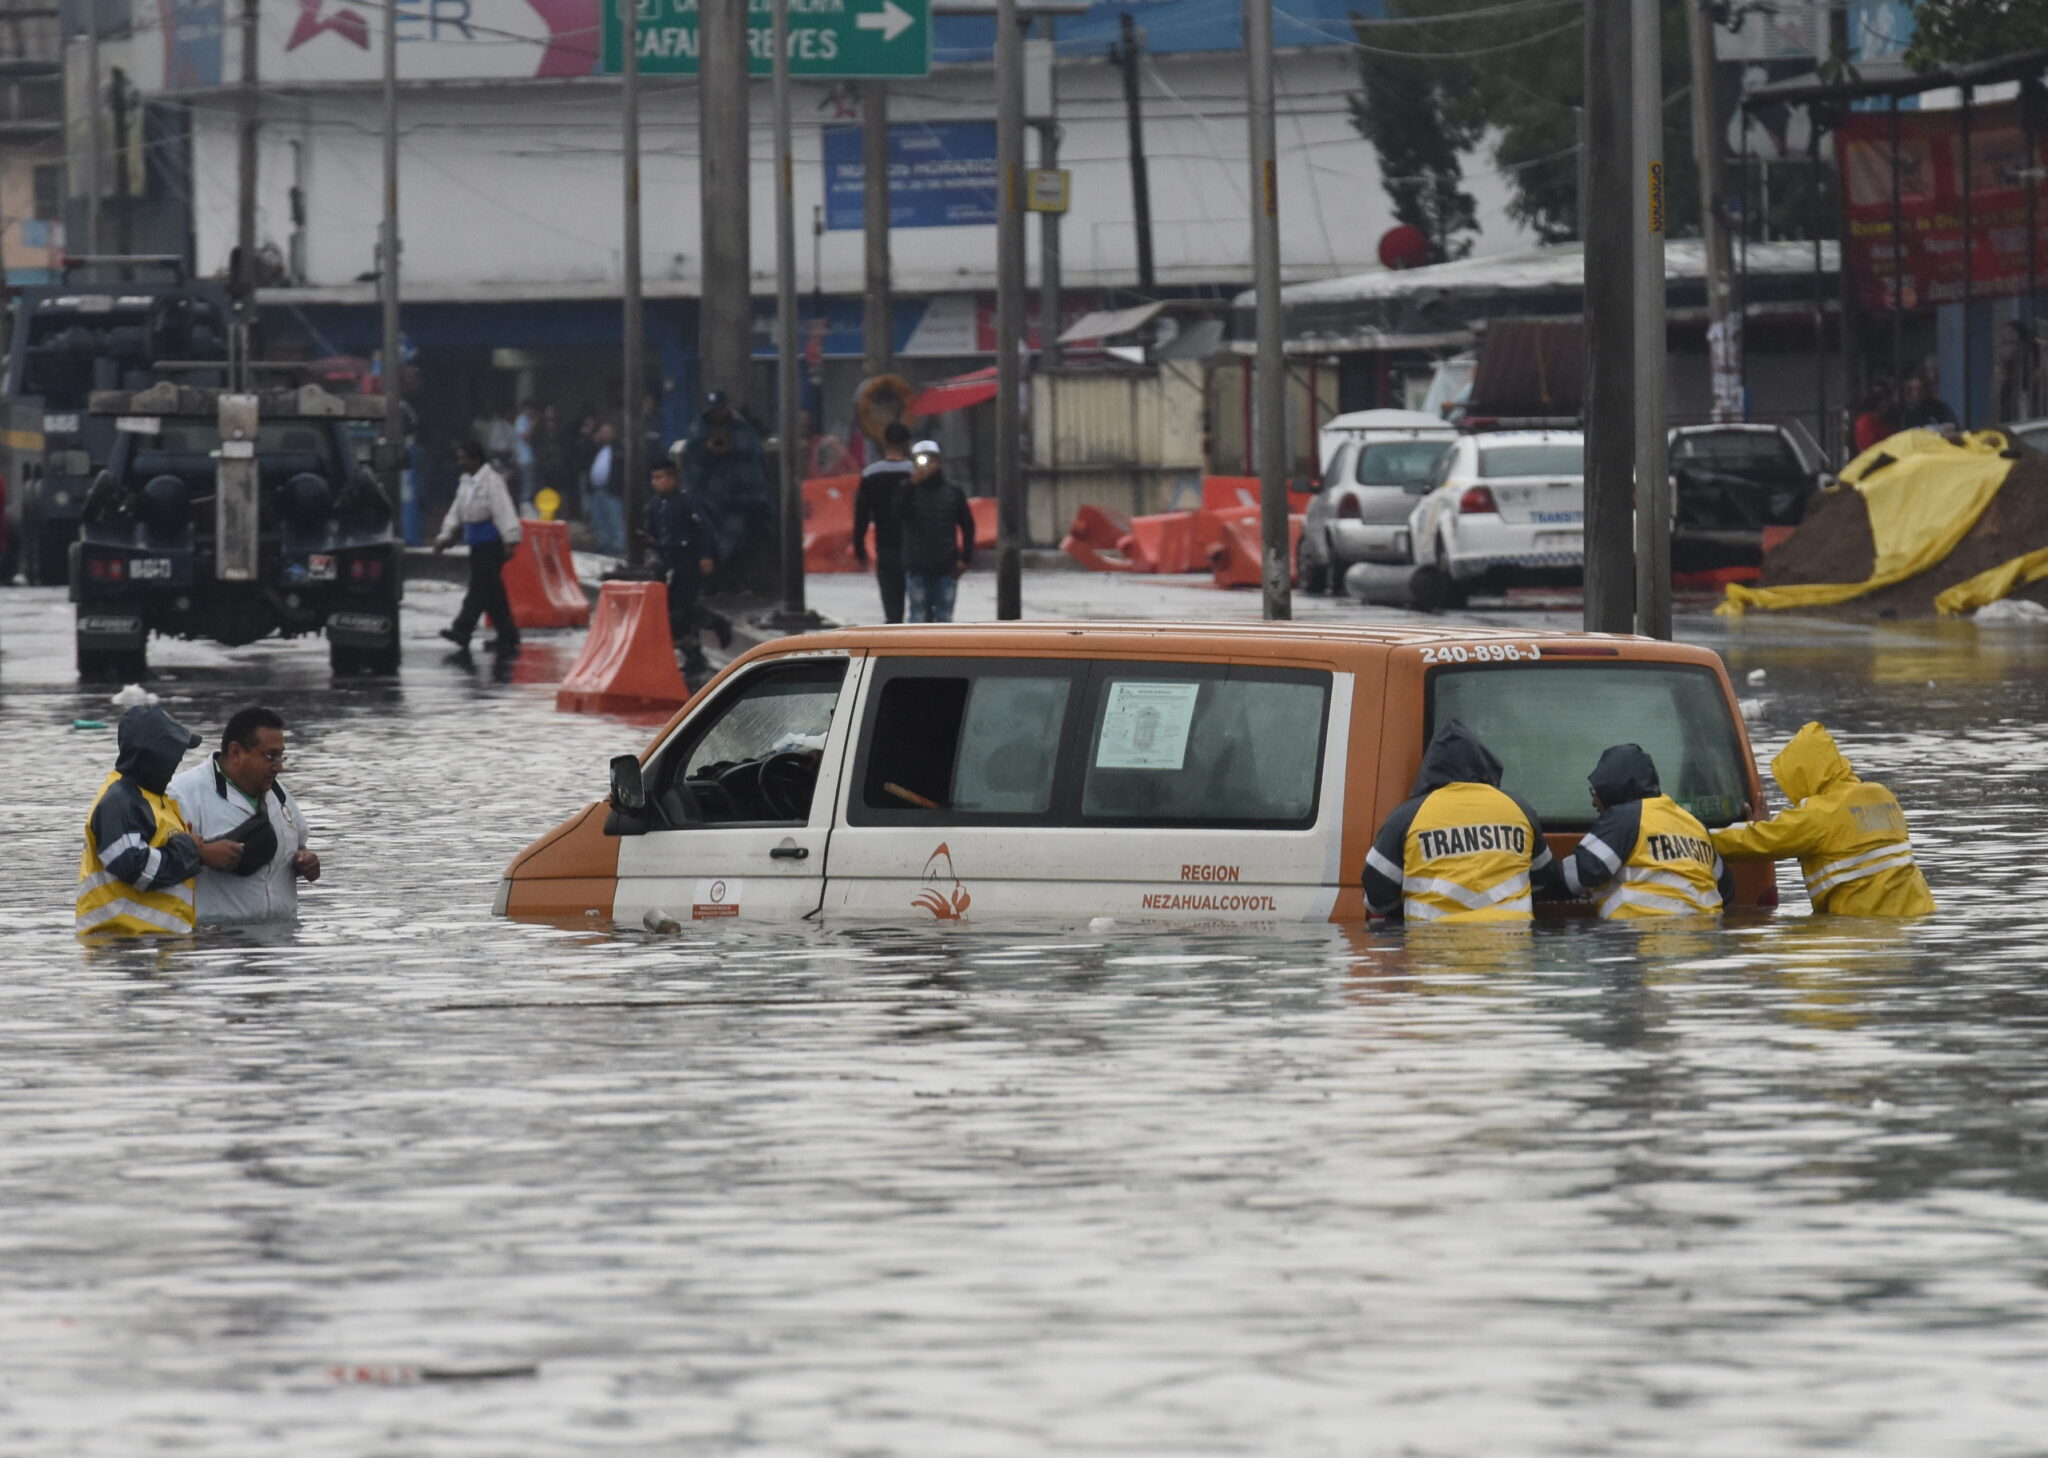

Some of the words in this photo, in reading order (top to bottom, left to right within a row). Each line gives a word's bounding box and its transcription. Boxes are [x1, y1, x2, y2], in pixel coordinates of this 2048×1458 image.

[634, 27, 698, 57] AFA
[1530, 511, 1584, 523] TRANSIT
[1419, 644, 1541, 664] 240-896-J
[1418, 825, 1525, 859] TRANSITO
[1181, 864, 1240, 881] REGION
[1142, 894, 1276, 911] NEZAHUALCOYOTL
